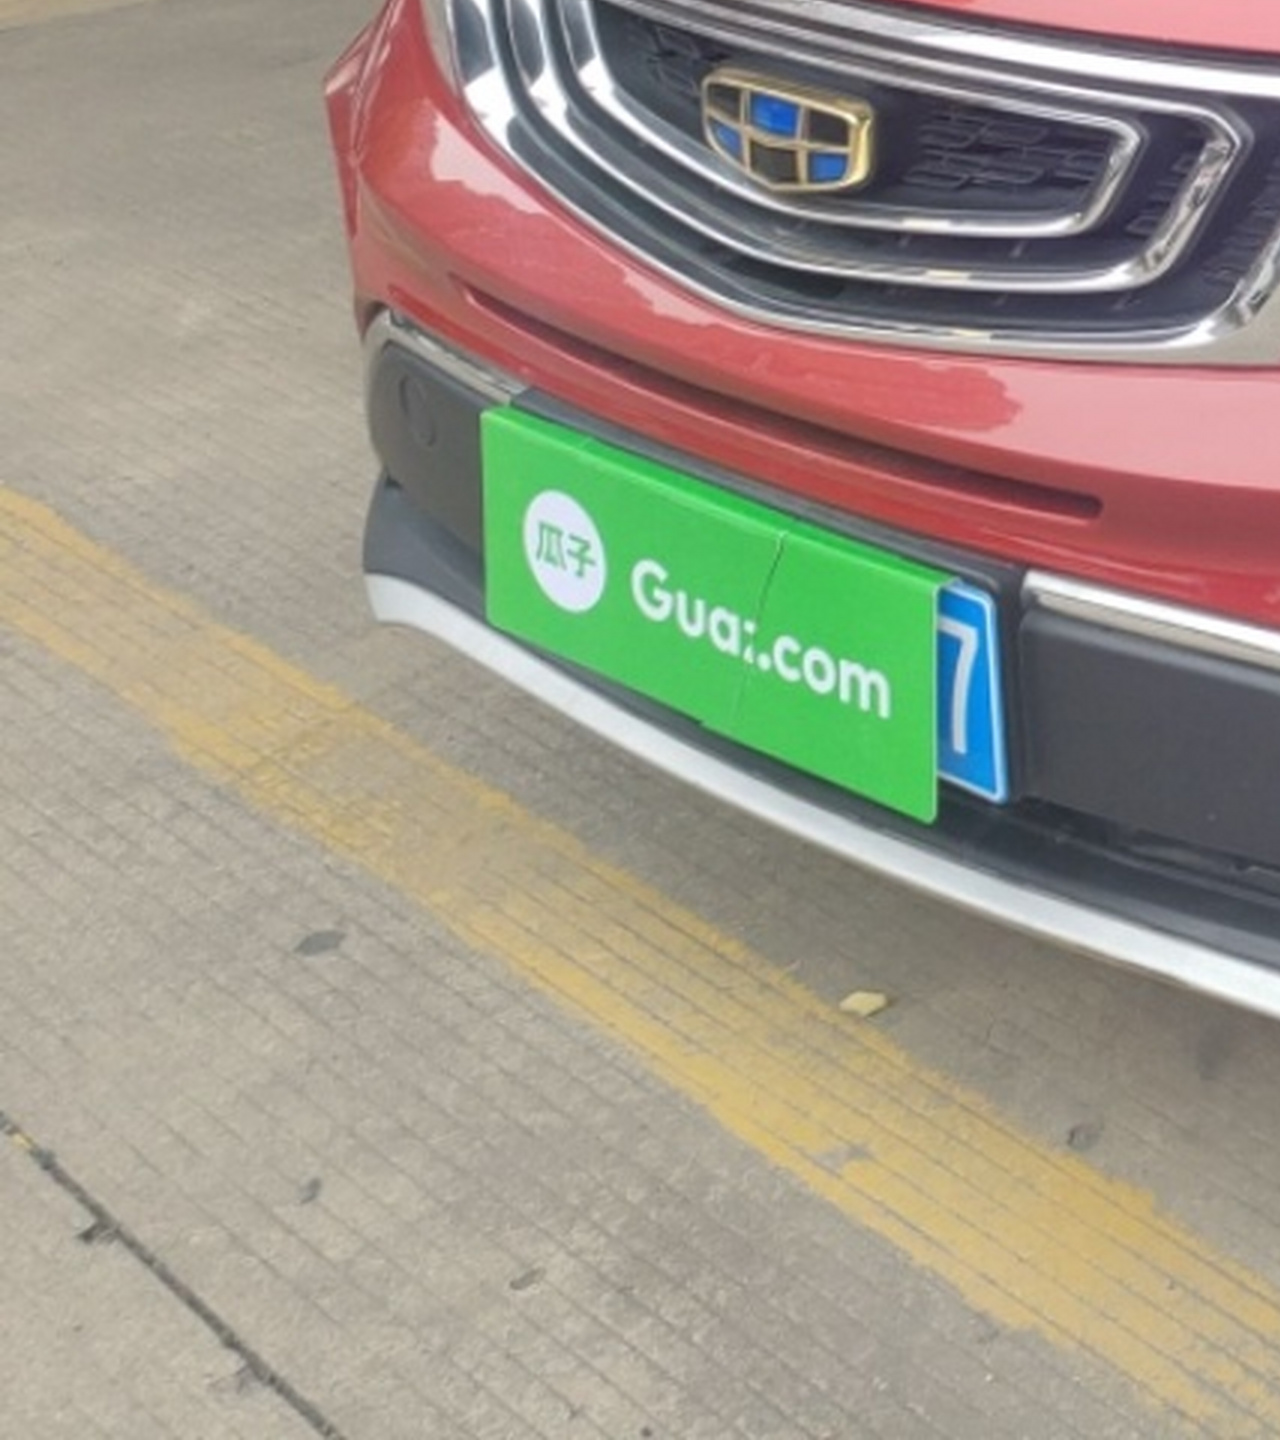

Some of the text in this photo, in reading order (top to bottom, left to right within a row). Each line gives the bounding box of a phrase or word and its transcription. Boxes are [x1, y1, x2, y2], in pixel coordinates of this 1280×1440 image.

[536, 520, 597, 578] 瓜子
[631, 559, 892, 719] Gua.com
[937, 615, 981, 755] 7
